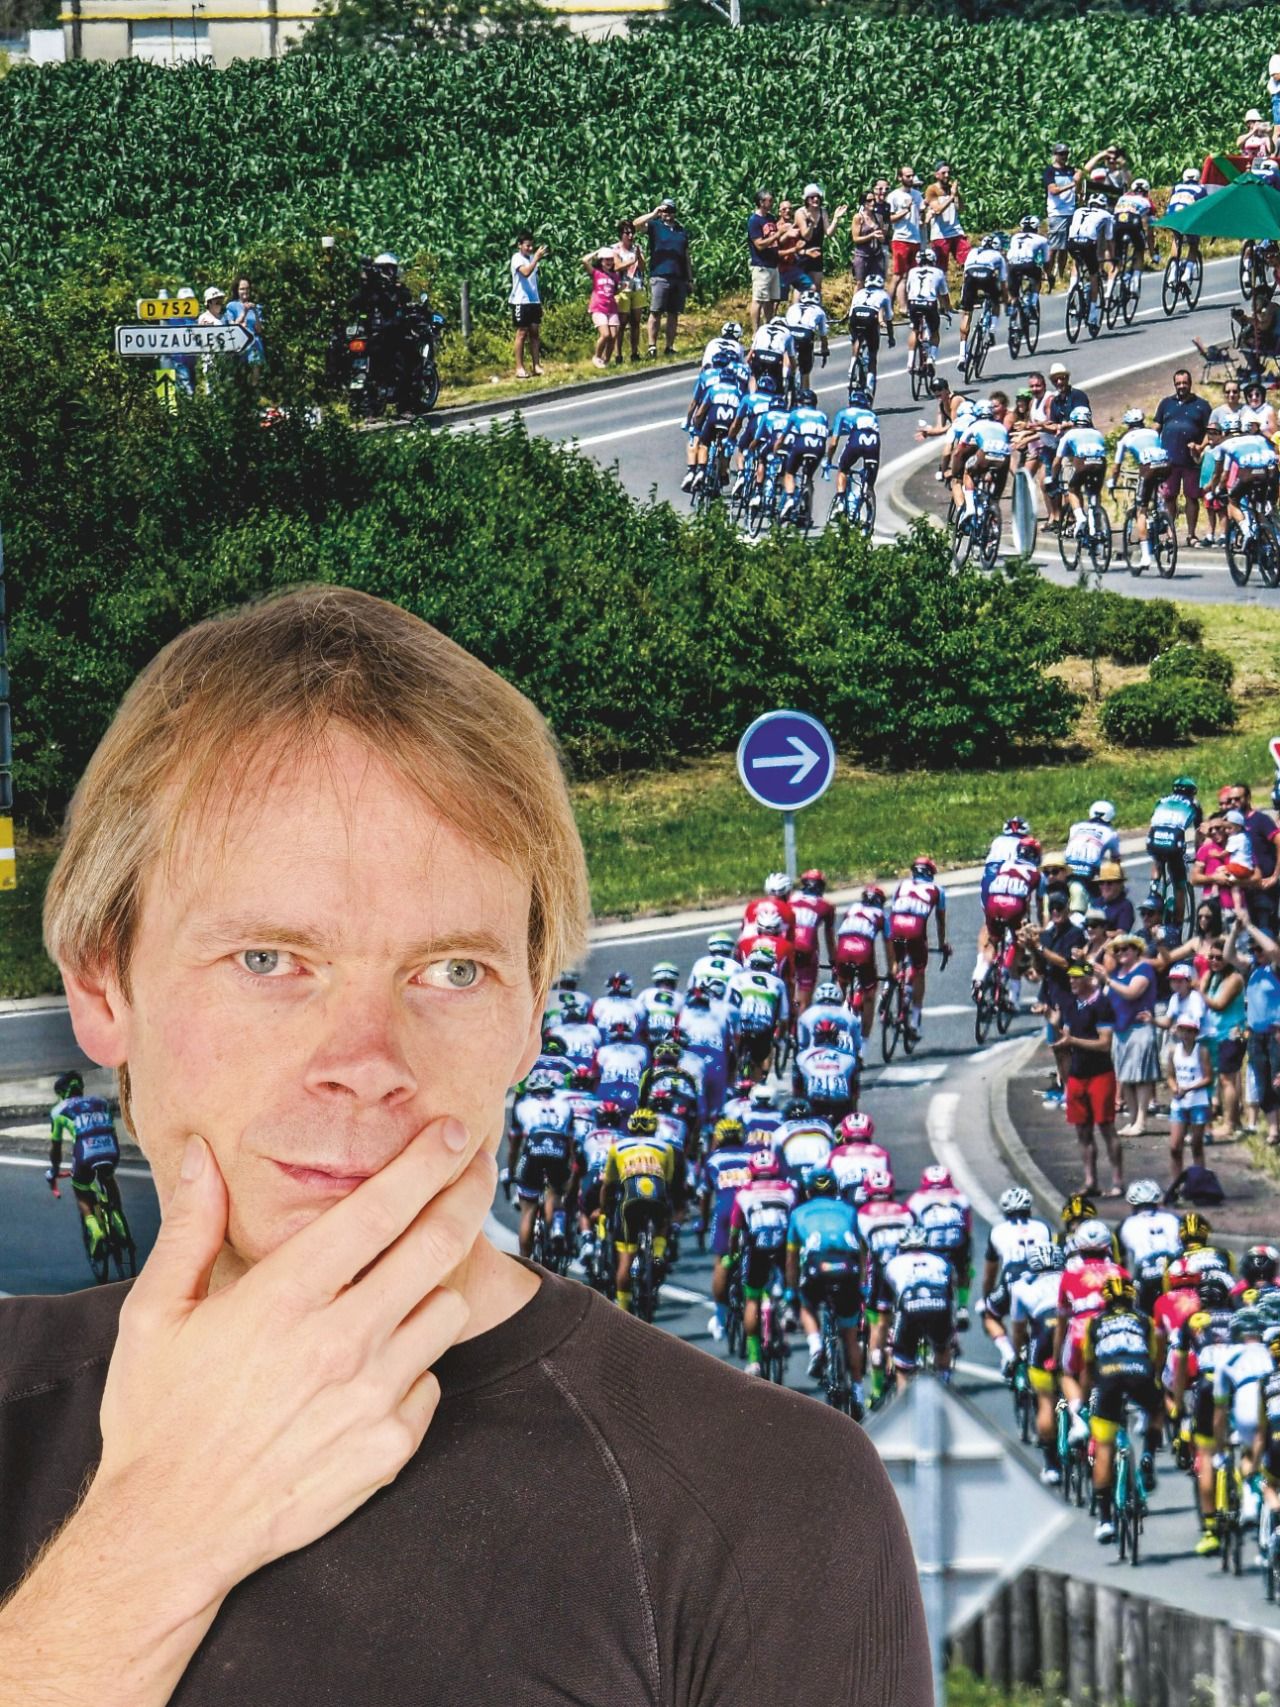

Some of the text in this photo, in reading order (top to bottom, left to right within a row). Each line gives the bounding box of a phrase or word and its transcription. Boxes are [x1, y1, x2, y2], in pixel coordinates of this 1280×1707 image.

[147, 301, 192, 317] D 752
[125, 332, 226, 348] POUZAUGES
